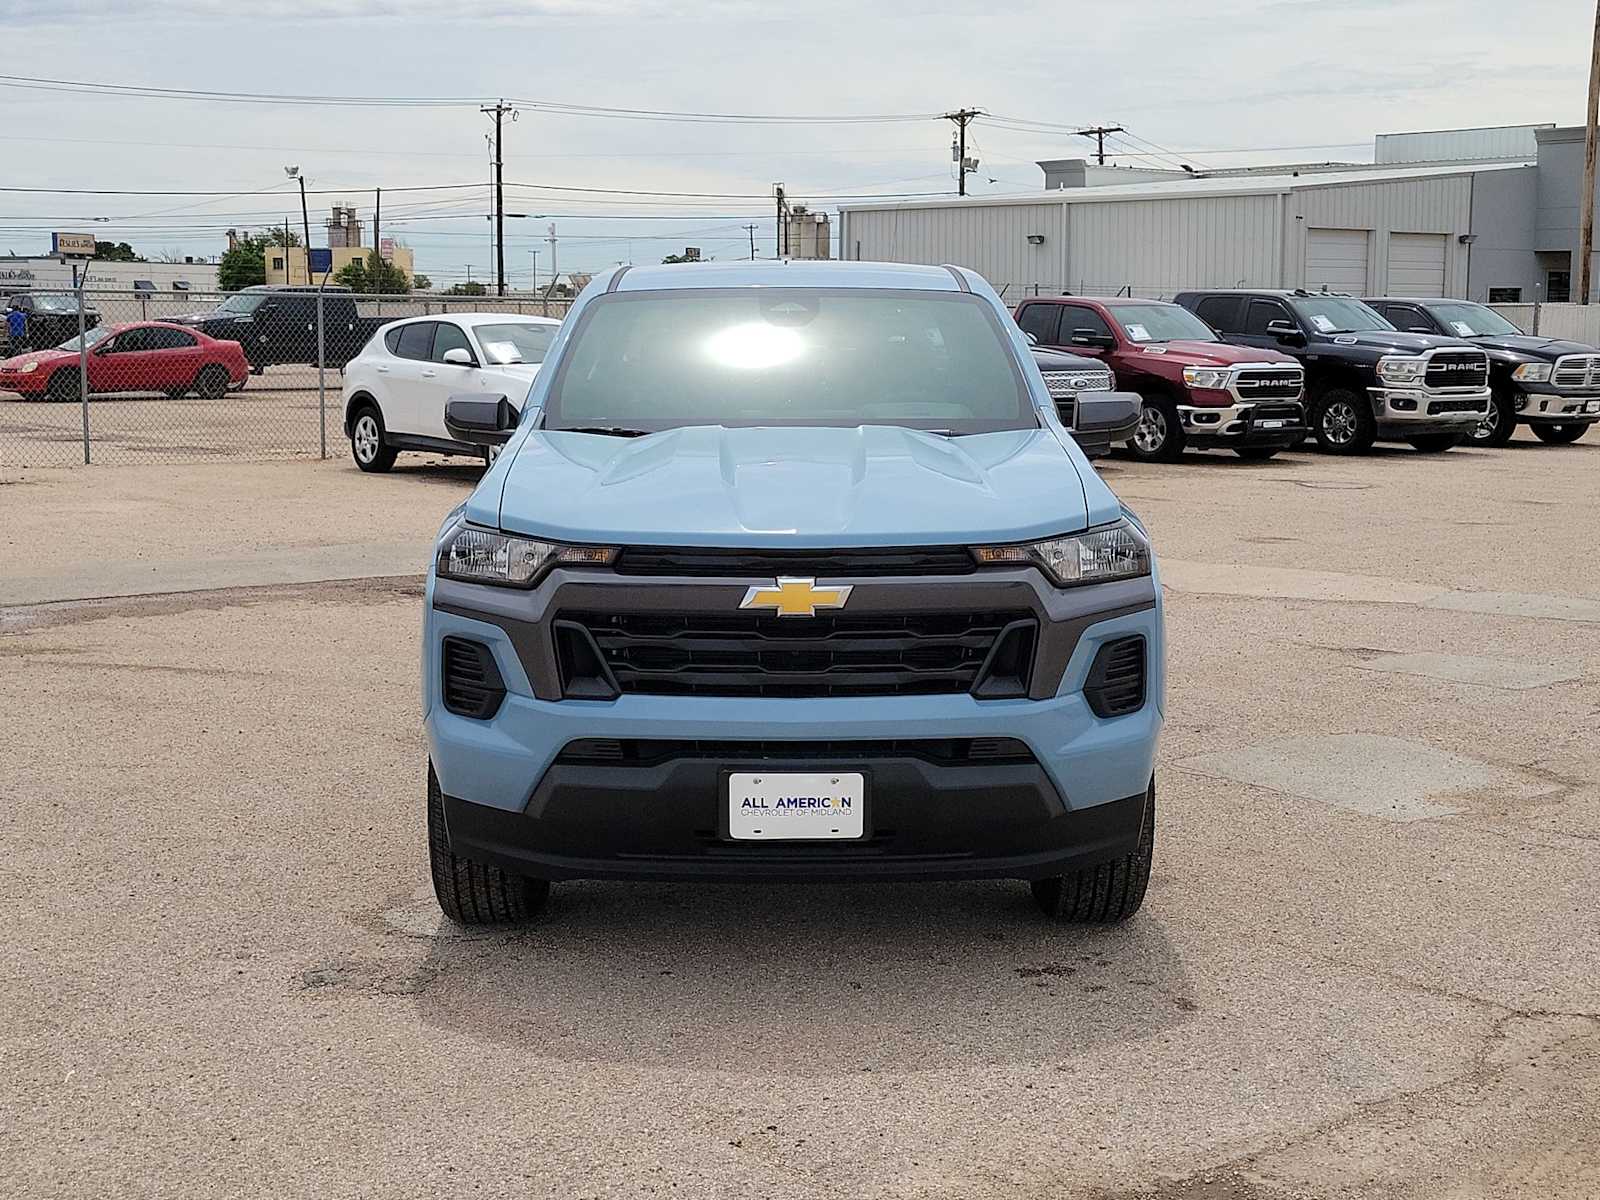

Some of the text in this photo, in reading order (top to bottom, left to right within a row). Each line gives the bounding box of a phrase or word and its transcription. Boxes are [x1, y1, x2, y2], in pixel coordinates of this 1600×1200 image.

[1448, 363, 1474, 371] RAM
[741, 797, 769, 809] ALL
[740, 808, 852, 817] CHEVROLET OF MIDLAND
